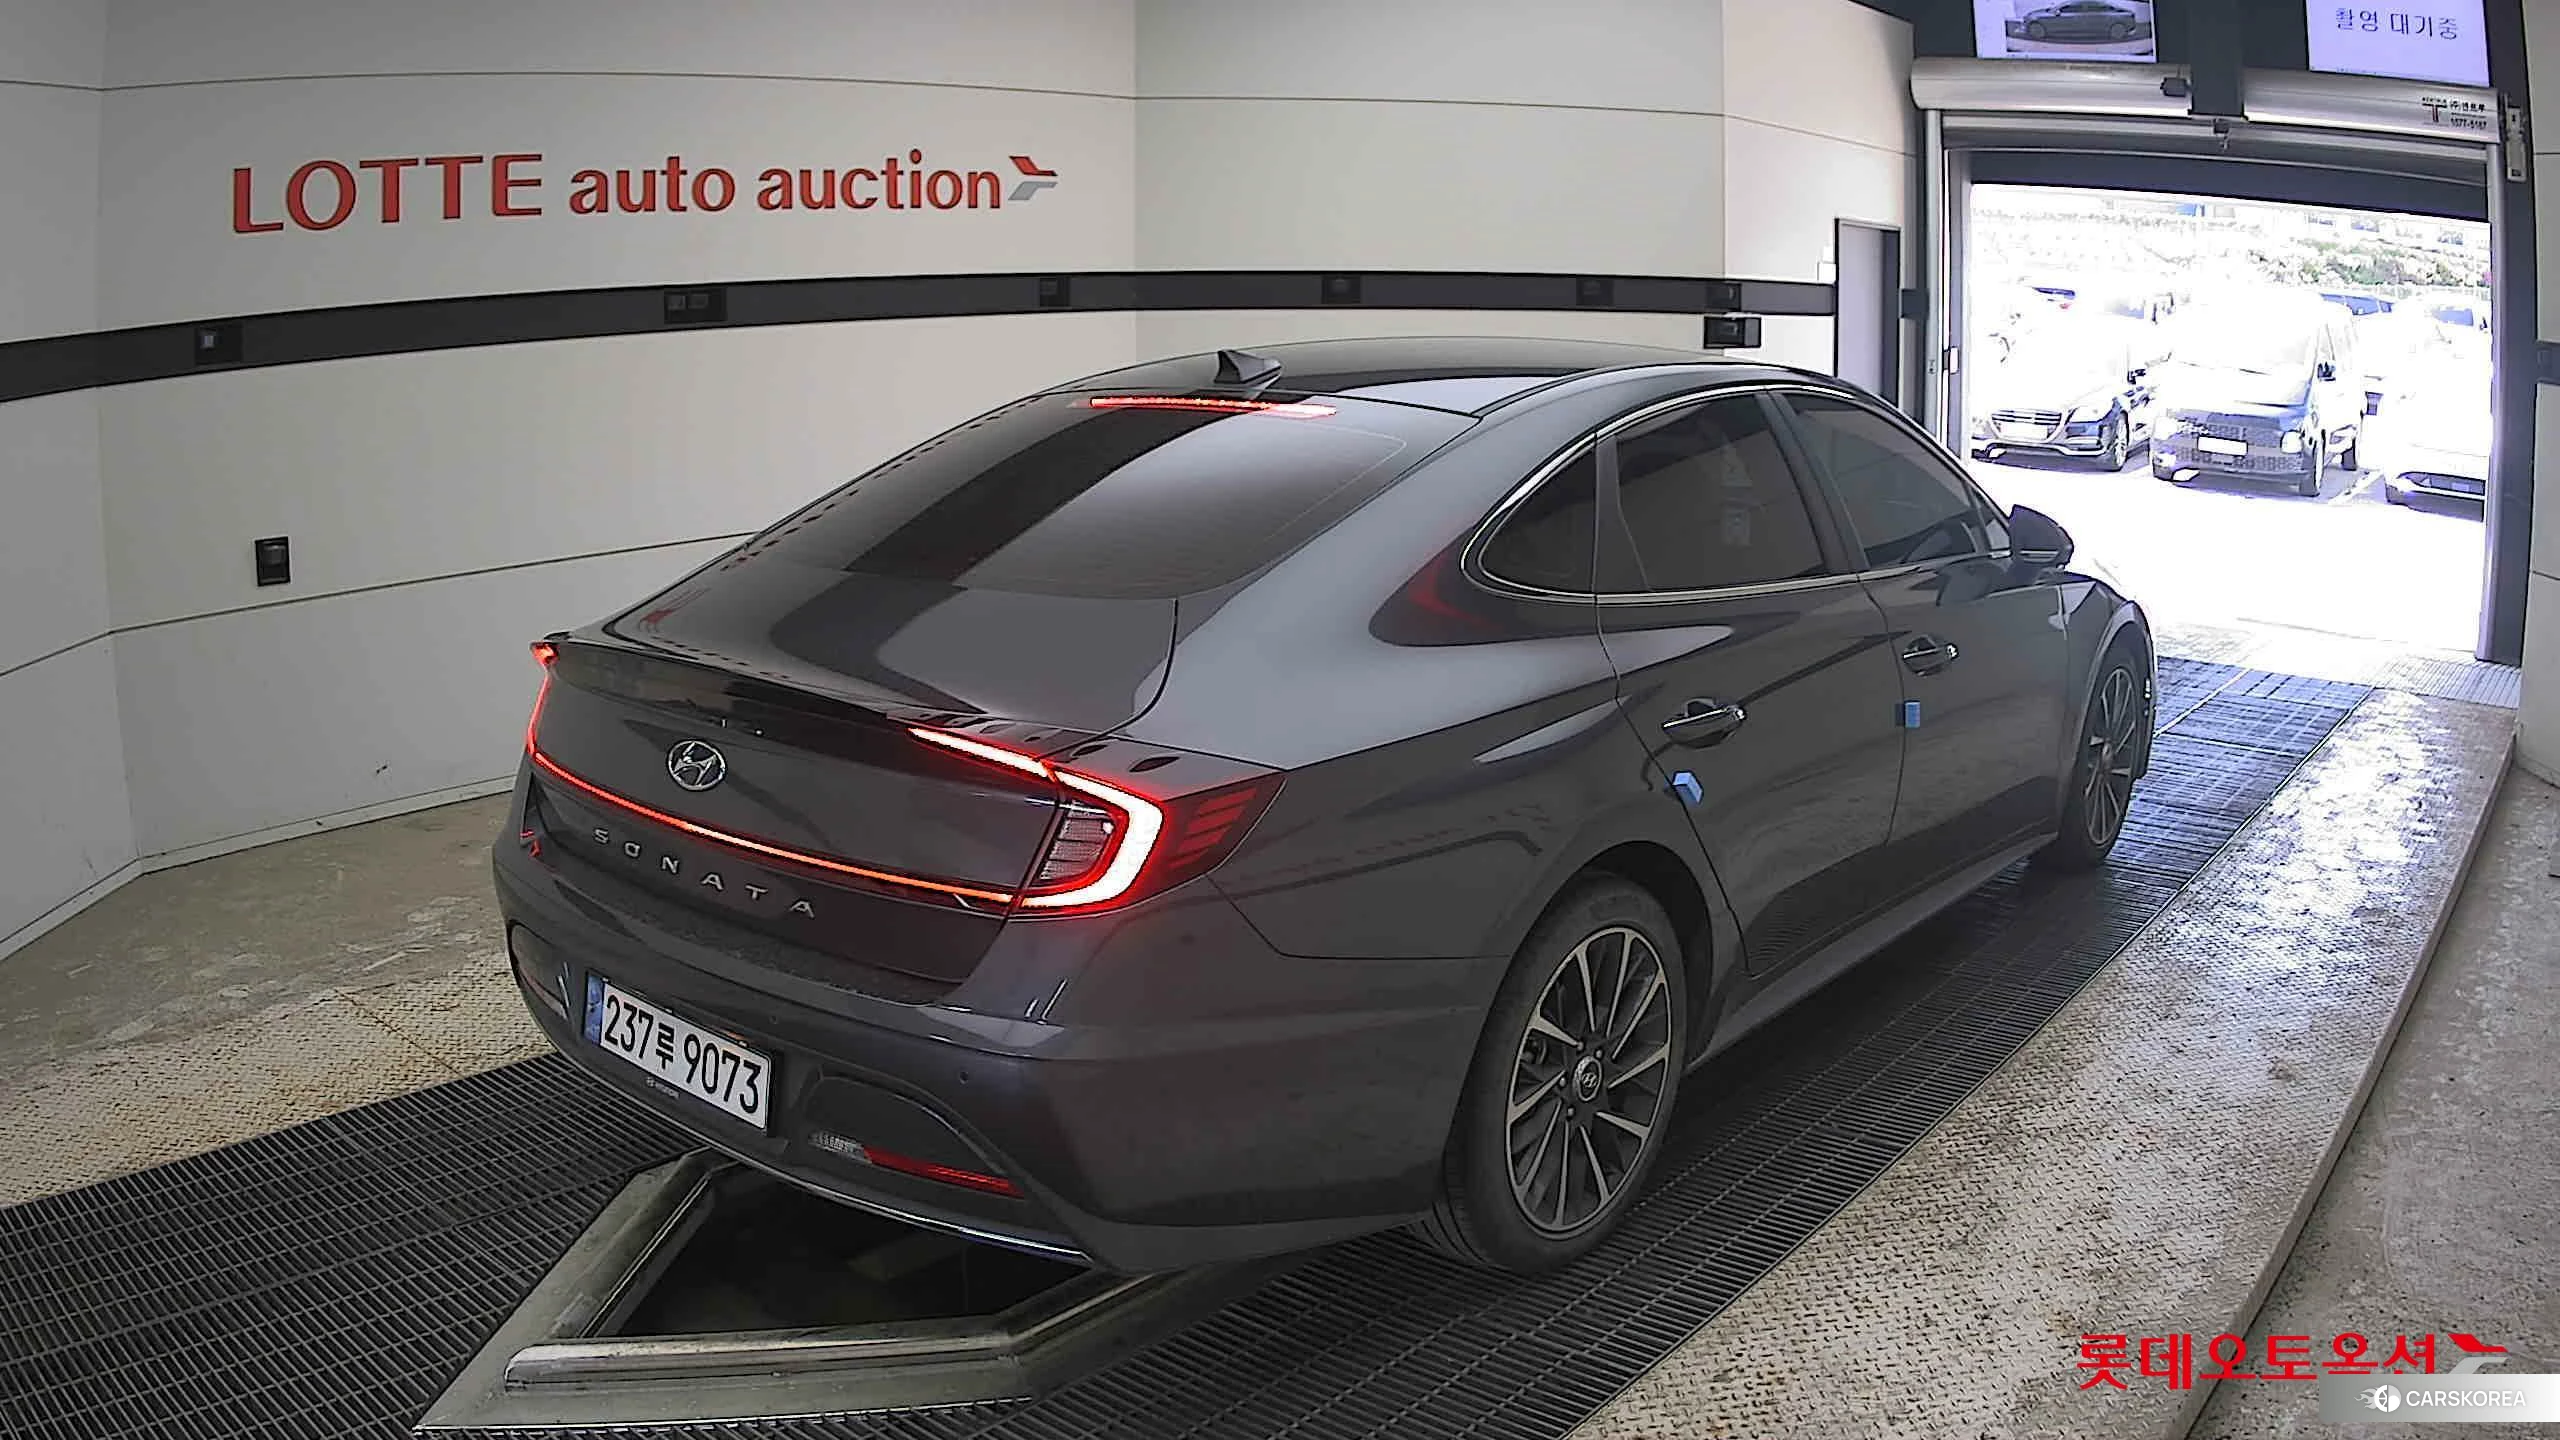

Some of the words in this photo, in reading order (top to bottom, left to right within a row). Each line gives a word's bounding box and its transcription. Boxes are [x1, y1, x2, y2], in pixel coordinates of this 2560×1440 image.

[2336, 8, 2378, 32] 촬영
[233, 153, 543, 233] LOTTE
[569, 155, 736, 214] auto
[757, 148, 1001, 210] auction
[594, 828, 816, 919] SONATA
[684, 1033, 762, 1114] 9073
